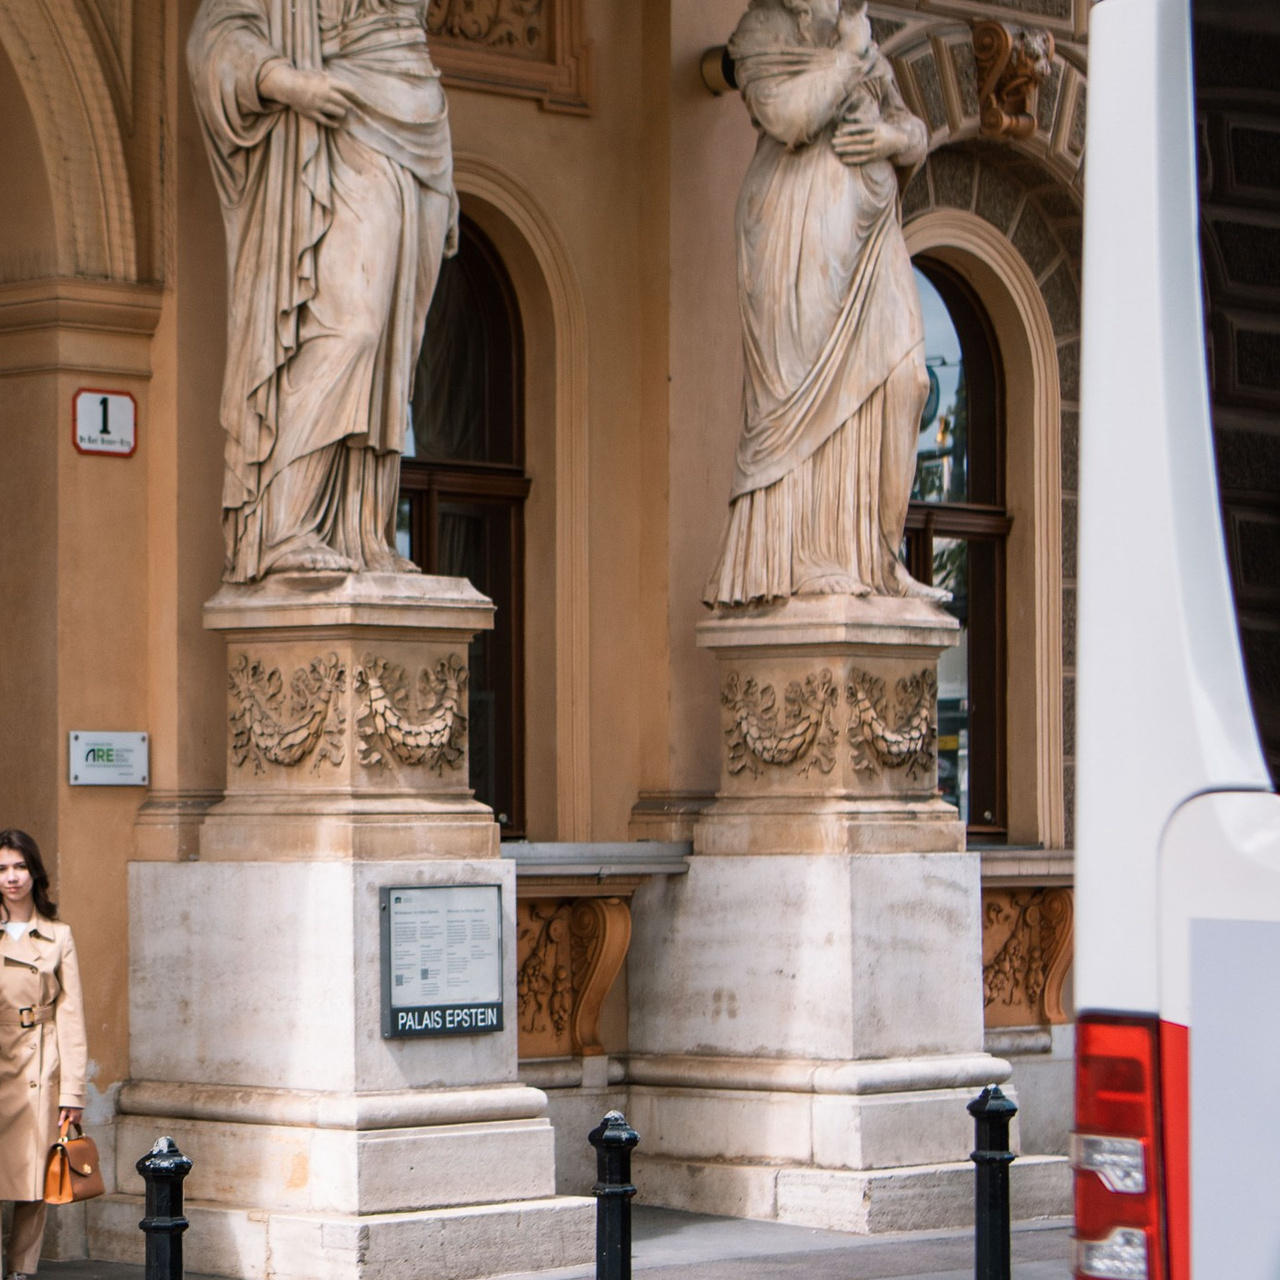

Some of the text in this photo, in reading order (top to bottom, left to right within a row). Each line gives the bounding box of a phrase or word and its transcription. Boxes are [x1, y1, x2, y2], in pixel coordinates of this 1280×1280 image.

[99, 396, 111, 435] 1
[85, 748, 115, 763] ARE
[398, 1007, 497, 1030] PALAIS EPSTEIN
